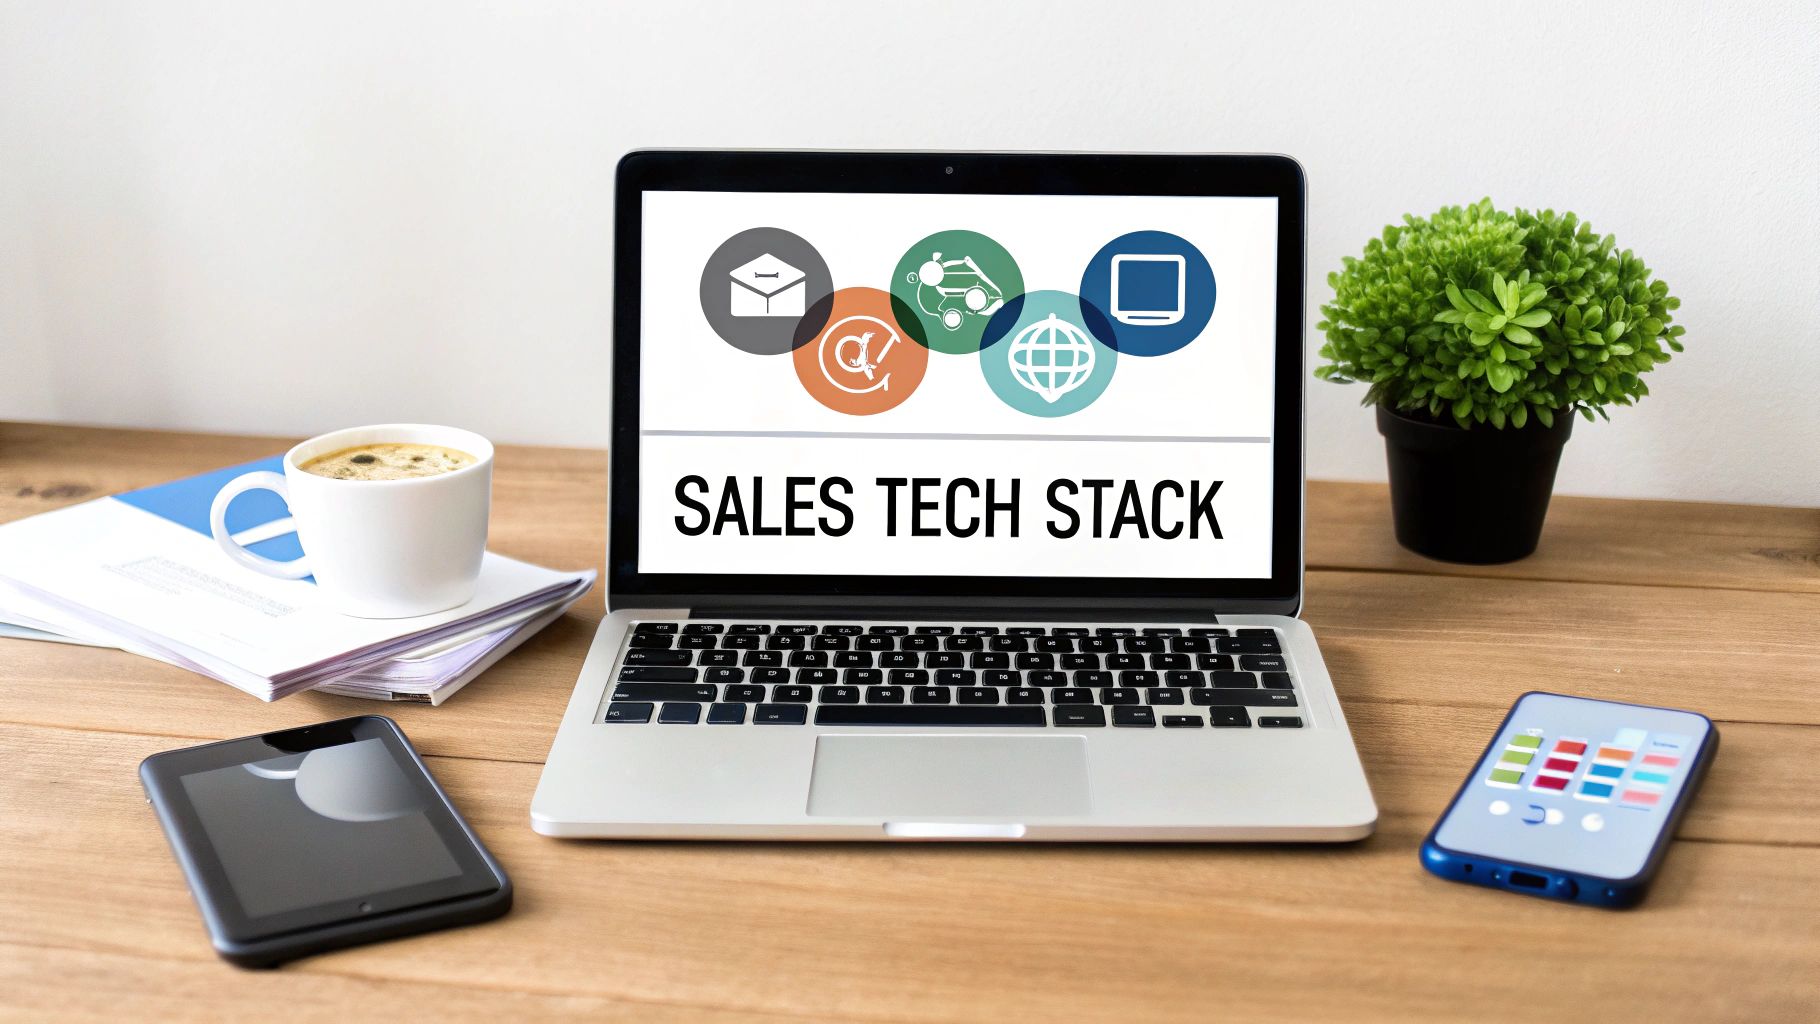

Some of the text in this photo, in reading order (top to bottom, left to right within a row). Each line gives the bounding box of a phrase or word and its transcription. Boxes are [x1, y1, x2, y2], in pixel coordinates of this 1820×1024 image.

[675, 474, 1225, 540] SALES TECH STACK
